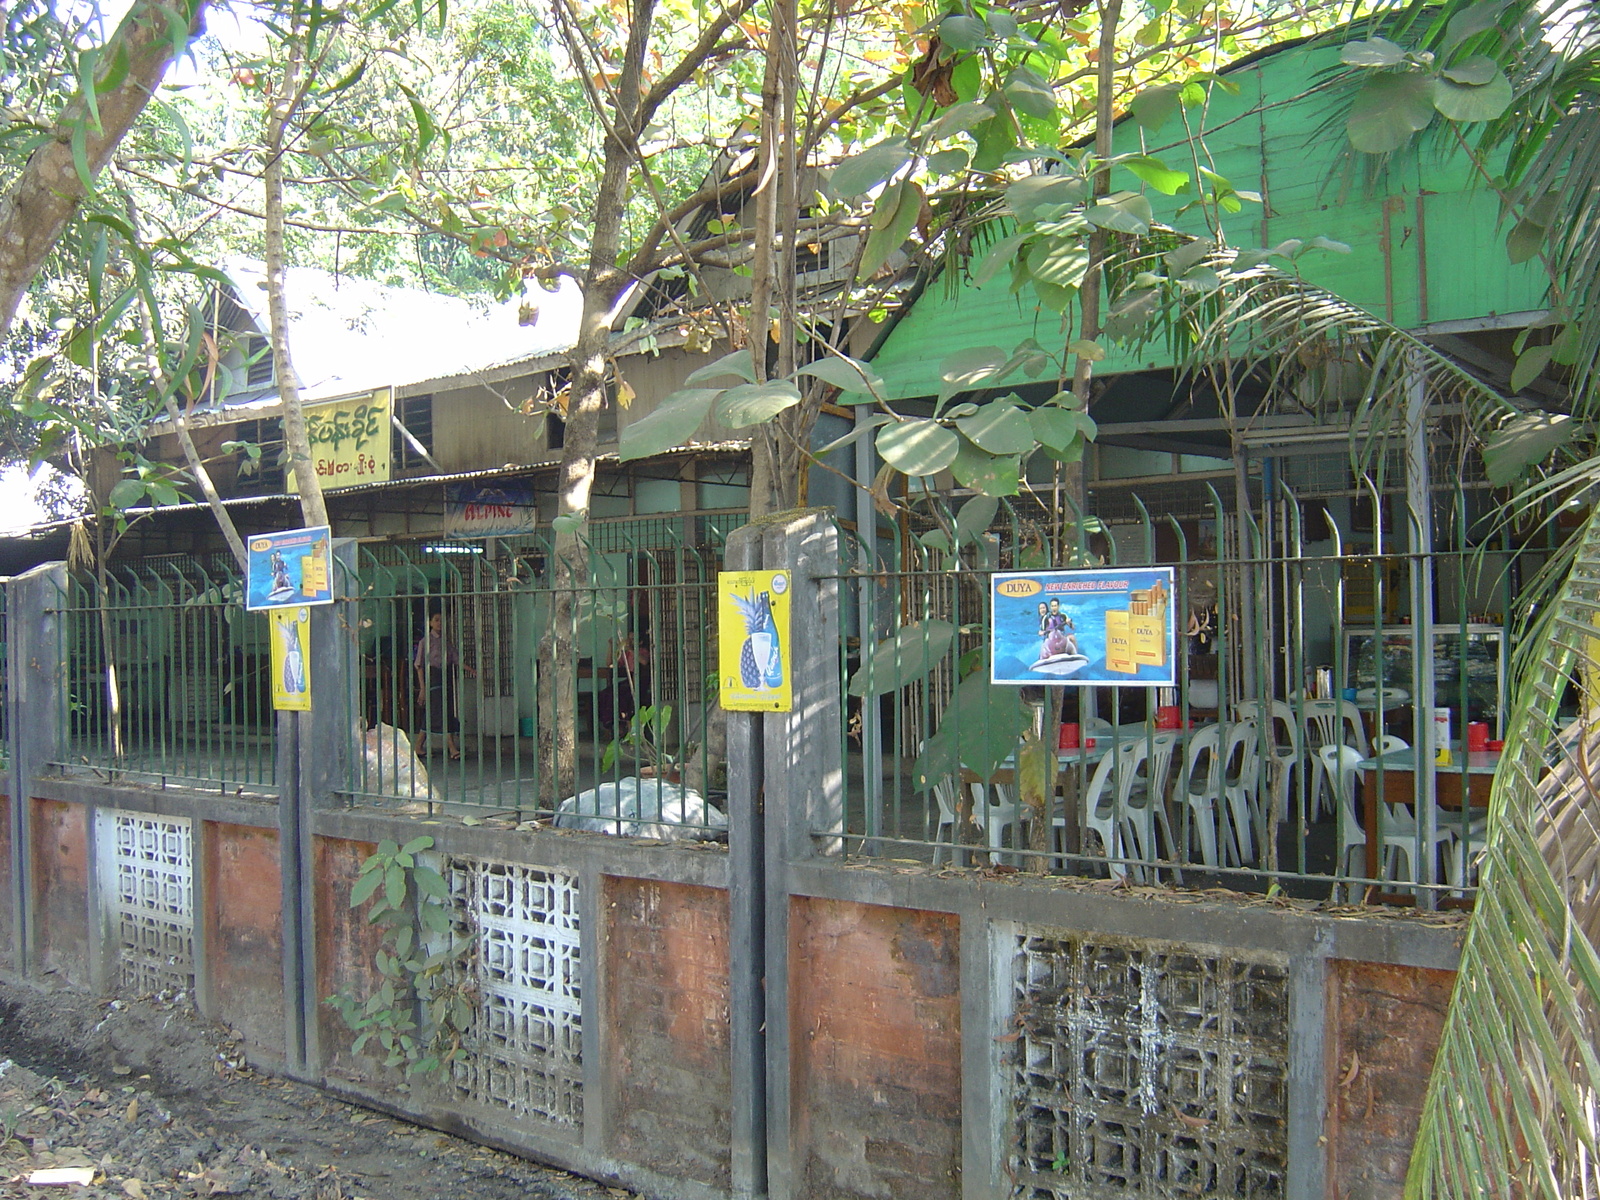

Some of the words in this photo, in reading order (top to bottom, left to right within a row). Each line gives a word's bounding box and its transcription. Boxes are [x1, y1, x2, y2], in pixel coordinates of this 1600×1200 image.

[1006, 582, 1032, 593] DUYA
[1045, 582, 1062, 591] NEW
[1062, 581, 1096, 591] ENRICHED
[1097, 580, 1130, 590] FLAVOUR
[1136, 628, 1153, 636] DUYA
[1111, 637, 1128, 645] DUYA
